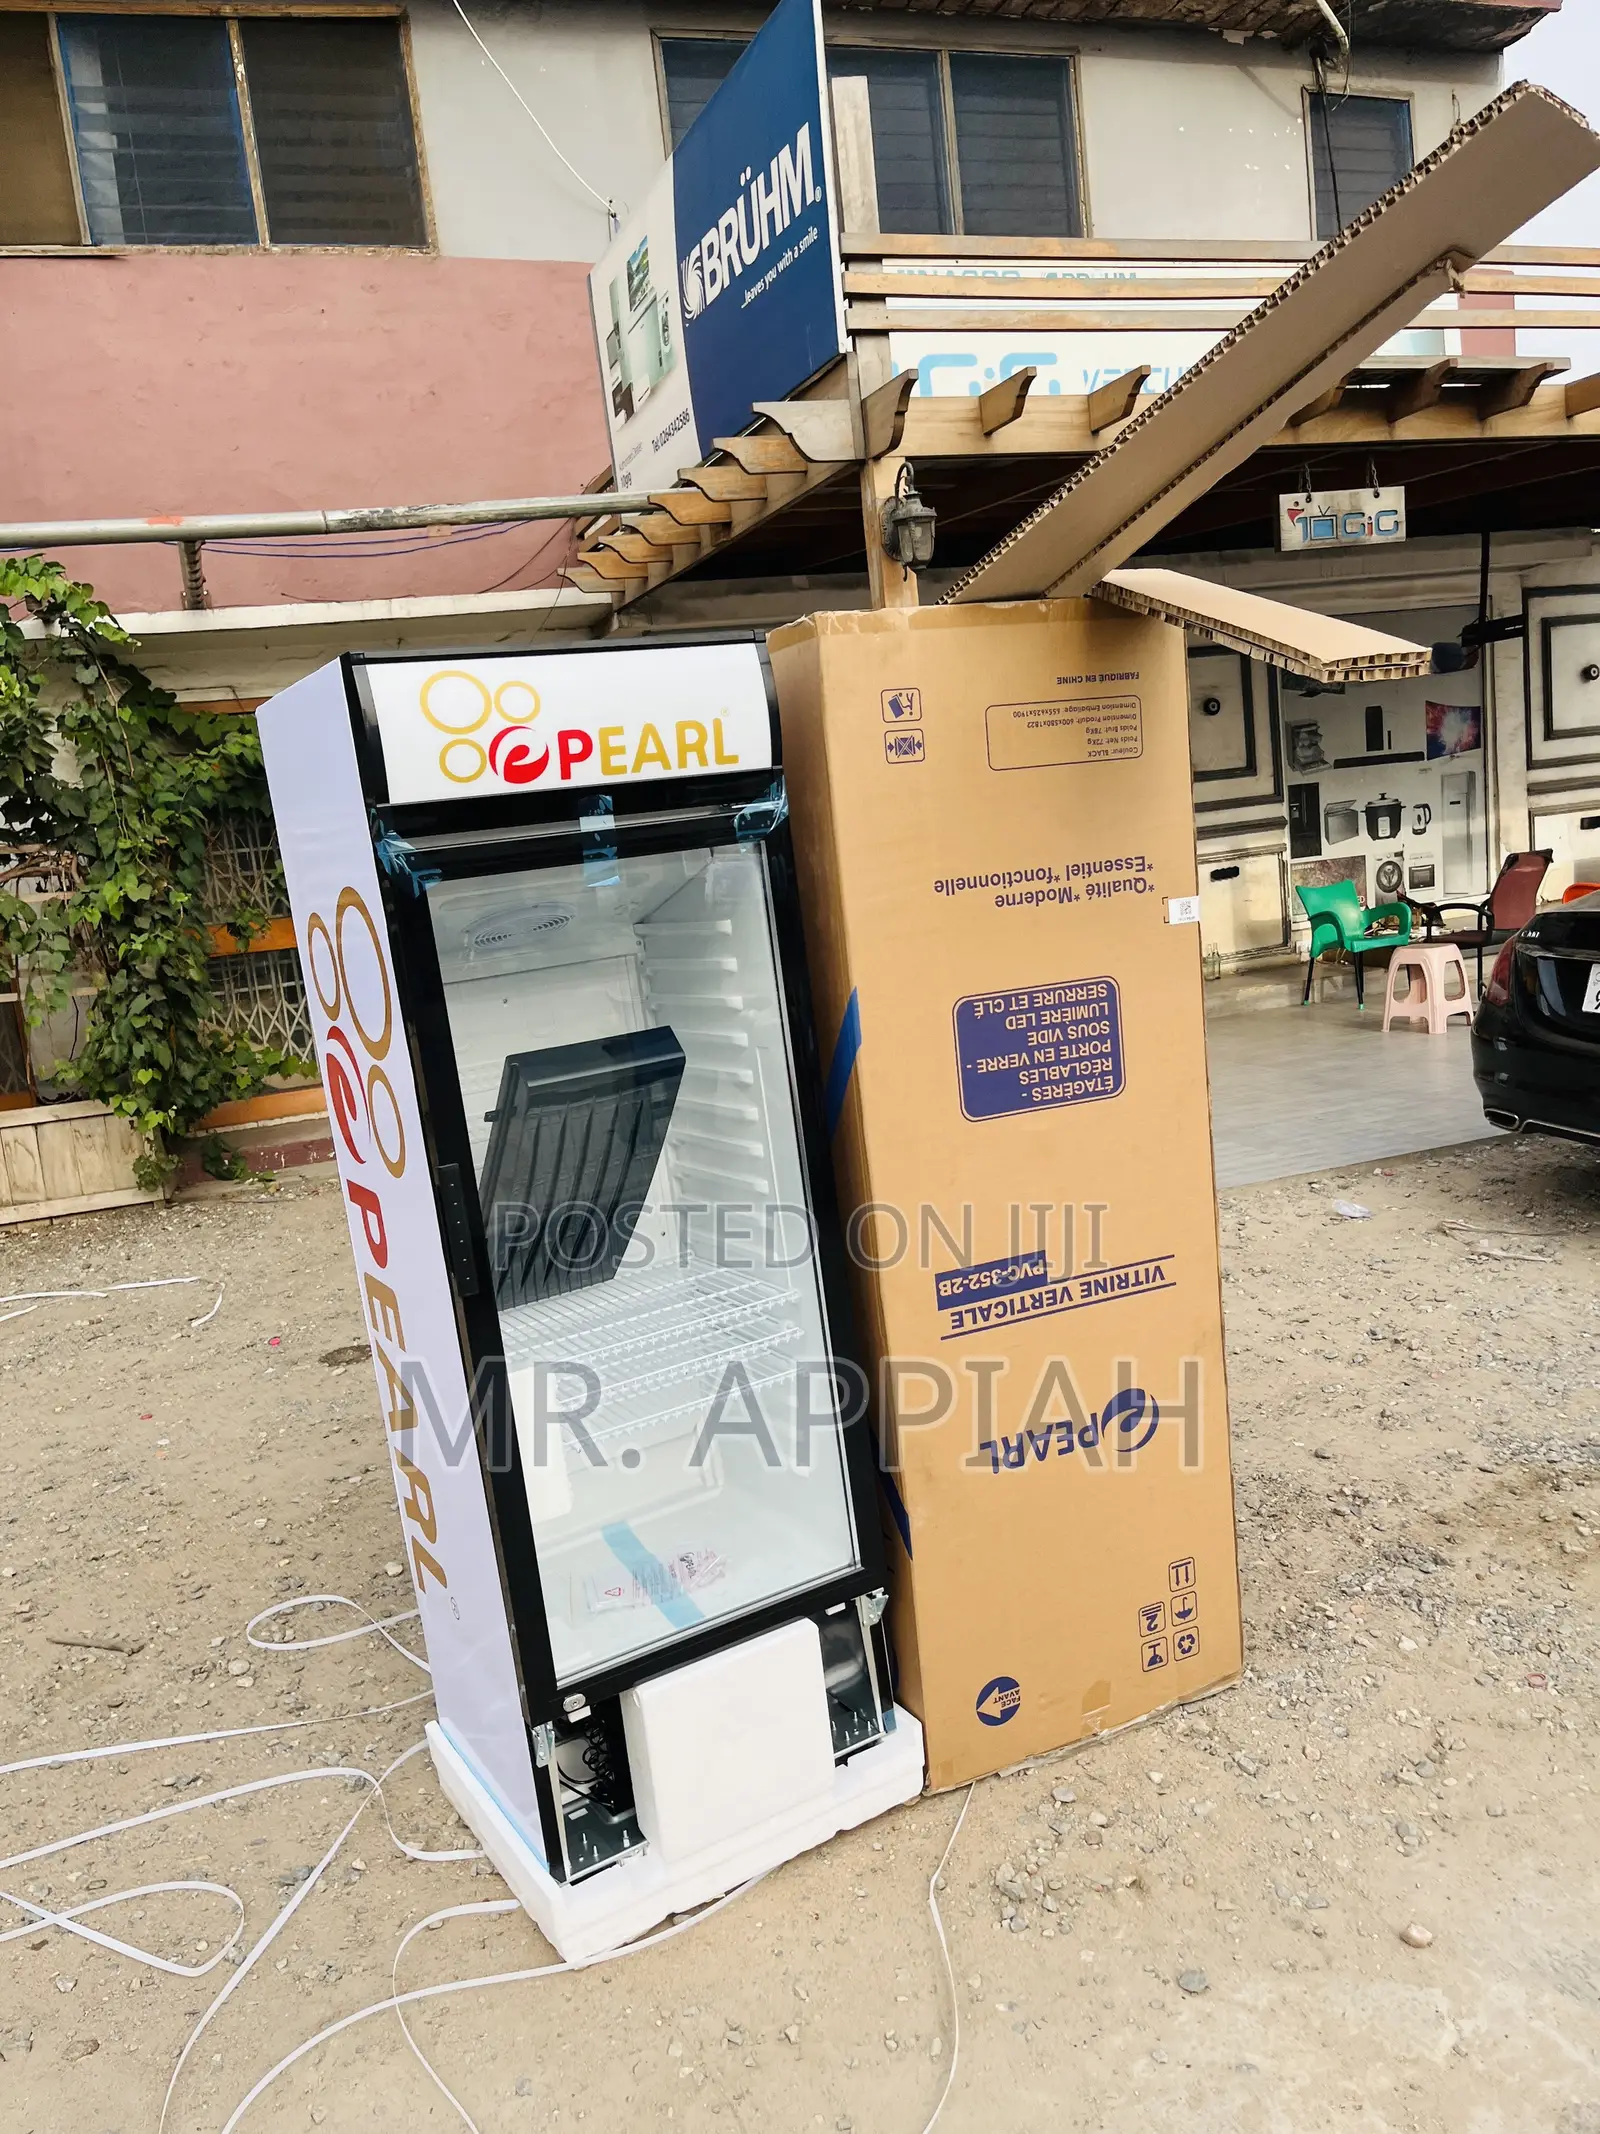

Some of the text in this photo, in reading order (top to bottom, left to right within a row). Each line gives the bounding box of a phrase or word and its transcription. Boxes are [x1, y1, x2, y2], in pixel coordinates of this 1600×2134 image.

[764, 265, 777, 290] you
[776, 247, 793, 273] with
[793, 245, 799, 258] a
[799, 225, 818, 254] smile
[1056, 676, 1083, 685] CHINE
[1085, 675, 1097, 683] EN
[1101, 702, 1137, 710] Dimension
[1102, 713, 1137, 721] Dimension
[1120, 724, 1138, 732] Poids
[1120, 735, 1138, 743] Poids
[557, 717, 740, 781] PEARL
[1087, 737, 1103, 745] 72Kg
[1087, 748, 1109, 758] BLACK
[973, 983, 1108, 1020] SERRURE ET CLÉ
[1005, 1001, 1109, 1031] LUMIÈRE LED
[1027, 1020, 1110, 1047] SOUS VIDE
[1033, 1047, 1056, 1064] EN
[1059, 1039, 1112, 1061] PORTE
[977, 1052, 1031, 1074] VERRE
[1018, 1057, 1113, 1085] RÉGLABLES
[1031, 1075, 1114, 1102] ÉTAGÈRES
[938, 1257, 1045, 1297] PVC-352-2B
[951, 1265, 1166, 1330] VITRINE VERTICALE
[346, 1178, 448, 1595] PEARL
[979, 1412, 1100, 1474] PEARL
[992, 1688, 1021, 1704] AVANT
[1001, 1696, 1021, 1708] FACE
